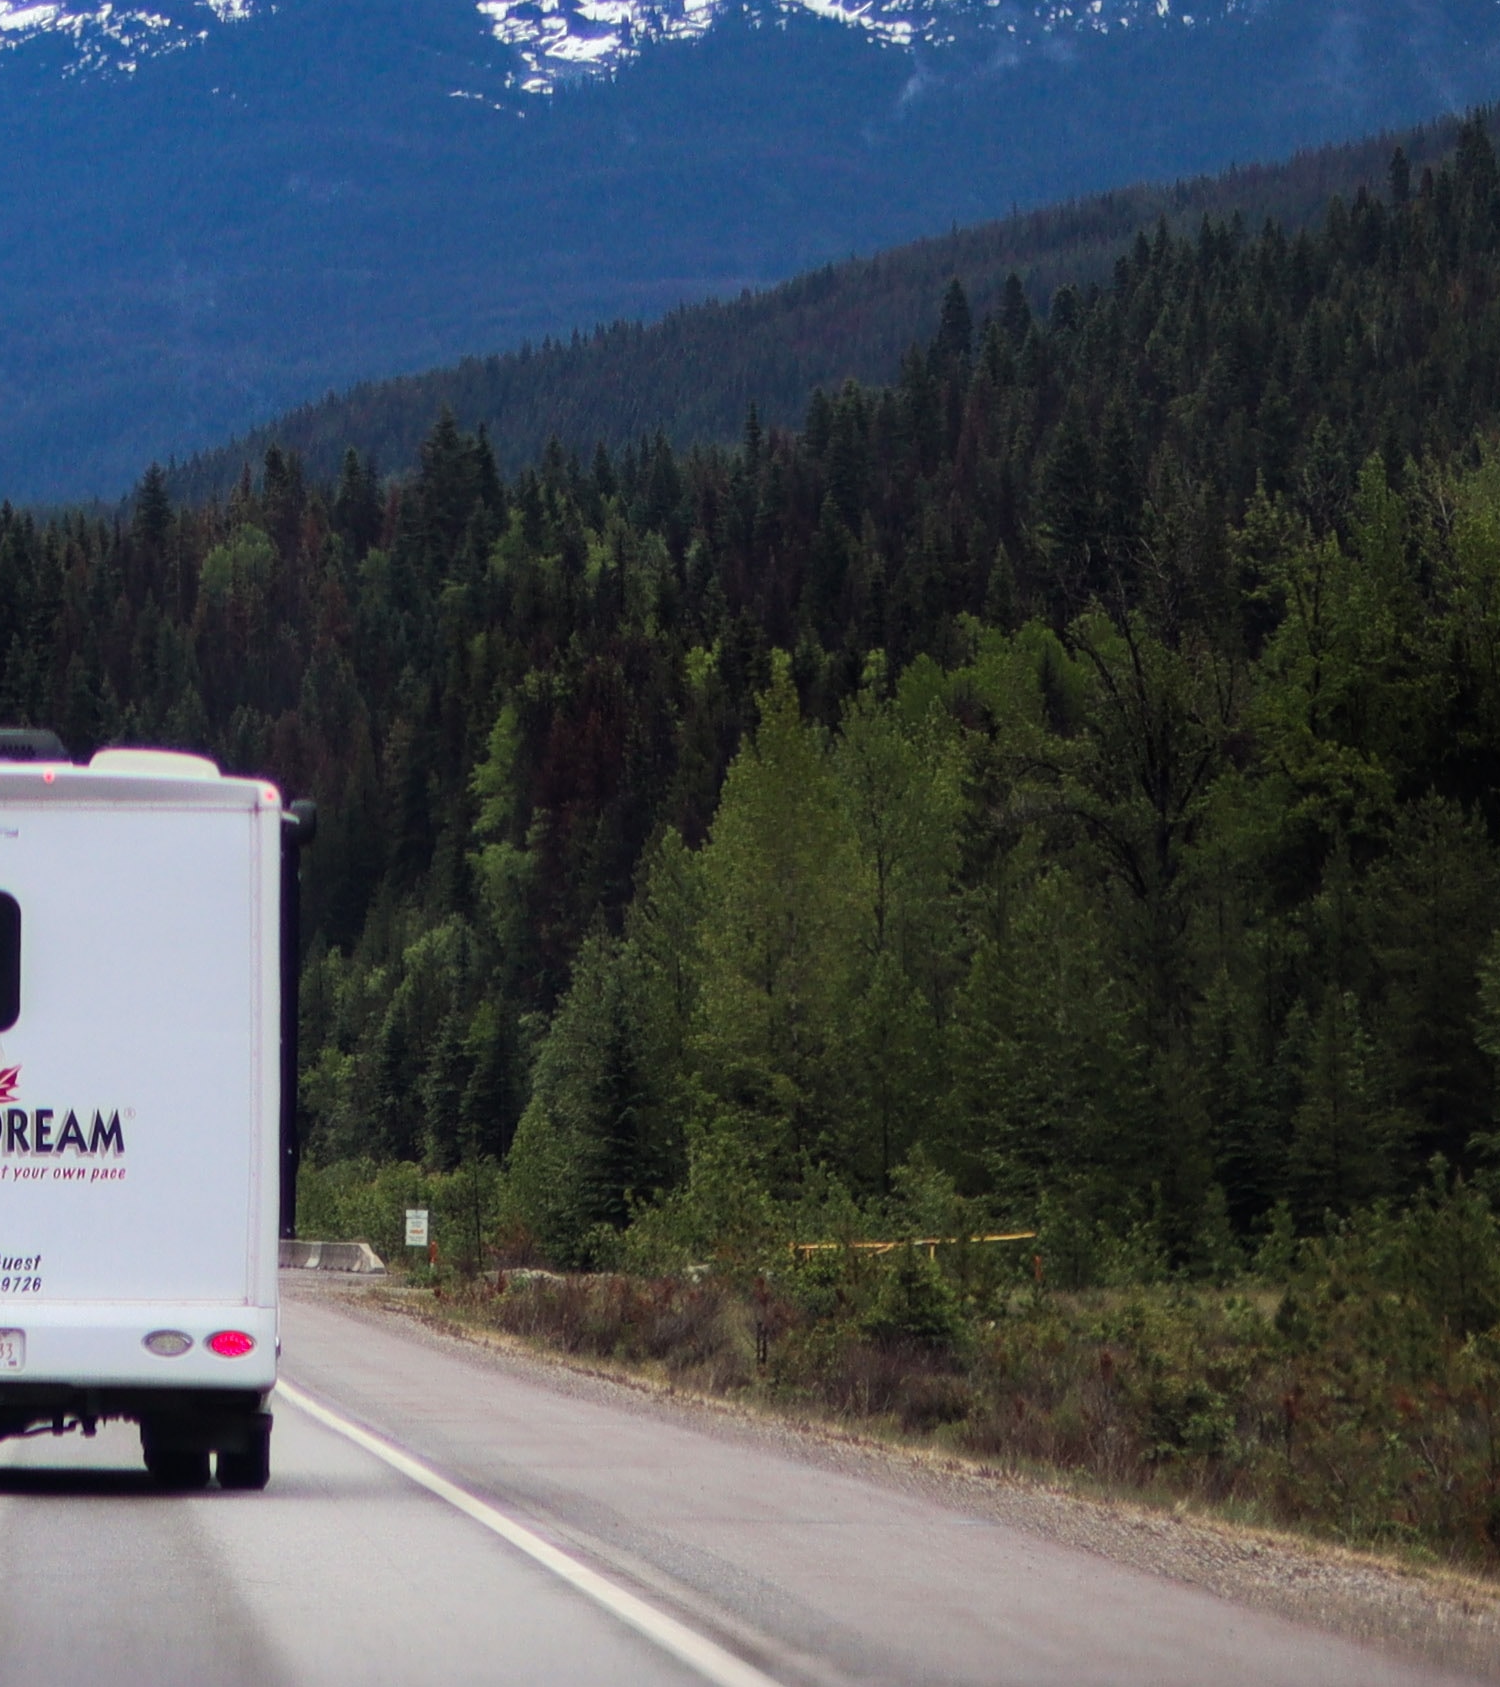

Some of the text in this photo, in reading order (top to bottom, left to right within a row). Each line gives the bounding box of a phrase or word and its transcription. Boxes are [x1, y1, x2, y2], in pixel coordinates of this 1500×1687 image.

[13, 1168, 48, 1182] your
[53, 1168, 86, 1179] own
[90, 1168, 126, 1183] pace
